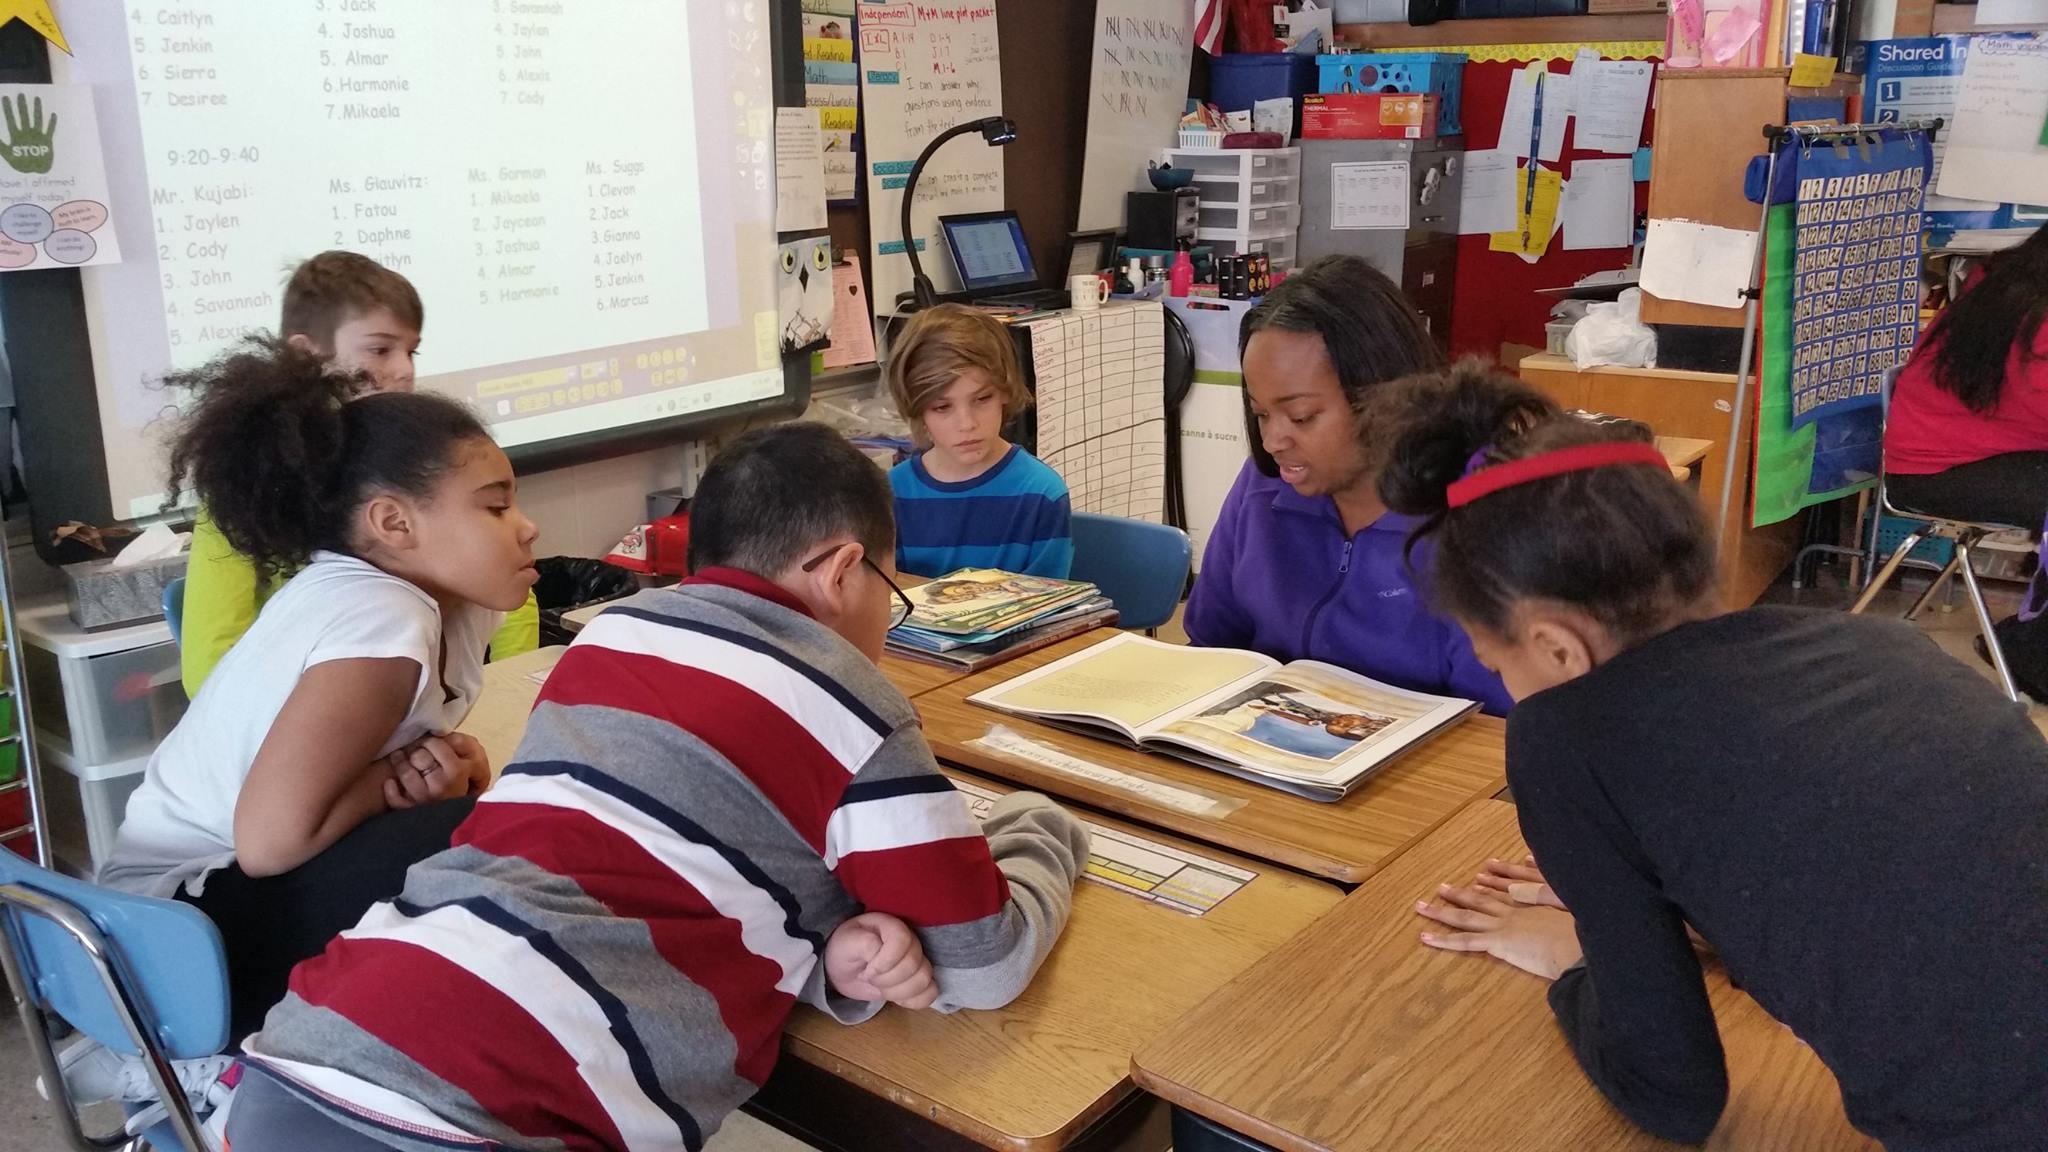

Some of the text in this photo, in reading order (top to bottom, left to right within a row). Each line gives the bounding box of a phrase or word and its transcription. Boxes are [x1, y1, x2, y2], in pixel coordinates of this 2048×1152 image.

[157, 9, 214, 29] Caitlyn
[860, 8, 910, 24] Independent
[343, 23, 396, 39] Joshua
[161, 36, 214, 53] Jenkin
[513, 44, 542, 59] John
[1878, 44, 1944, 62] Shared
[345, 50, 389, 66] Almar
[164, 64, 216, 80] Sierra
[1878, 64, 1924, 73] Discussion
[168, 91, 228, 106] Desiree
[518, 91, 545, 107] Cody
[1303, 96, 1325, 104] Scotch
[1886, 83, 1894, 100] 1
[12, 145, 49, 157] STOP
[167, 146, 260, 166] 9:20-9:40
[613, 159, 645, 176] Suggs
[329, 178, 357, 194] Ms.
[1812, 180, 1820, 198] 2
[1829, 179, 1838, 197] 3
[1843, 178, 1852, 194] 4
[1858, 176, 1865, 194] 5
[153, 187, 184, 205] Mr.
[490, 190, 541, 206] Mikaela
[354, 203, 397, 219] Fatou
[1811, 204, 1820, 221] 12
[1824, 203, 1835, 220] 13
[1839, 202, 1850, 218] 14
[184, 214, 240, 234] Jaylen
[358, 227, 412, 247] Daphne
[1833, 227, 1846, 243] 24
[186, 241, 228, 261] Cody
[495, 239, 541, 255] Joshua
[498, 263, 537, 279] Almar
[1904, 259, 1917, 277] 50
[190, 269, 232, 287] John
[500, 284, 560, 304] Harmonie
[1904, 282, 1915, 299] 60
[194, 290, 273, 315] Savannah
[1902, 305, 1914, 322] 70
[198, 325, 250, 342] Alexis
[1884, 330, 1894, 346] 79
[1901, 327, 1912, 344] 80
[1215, 432, 1238, 442] sucre
